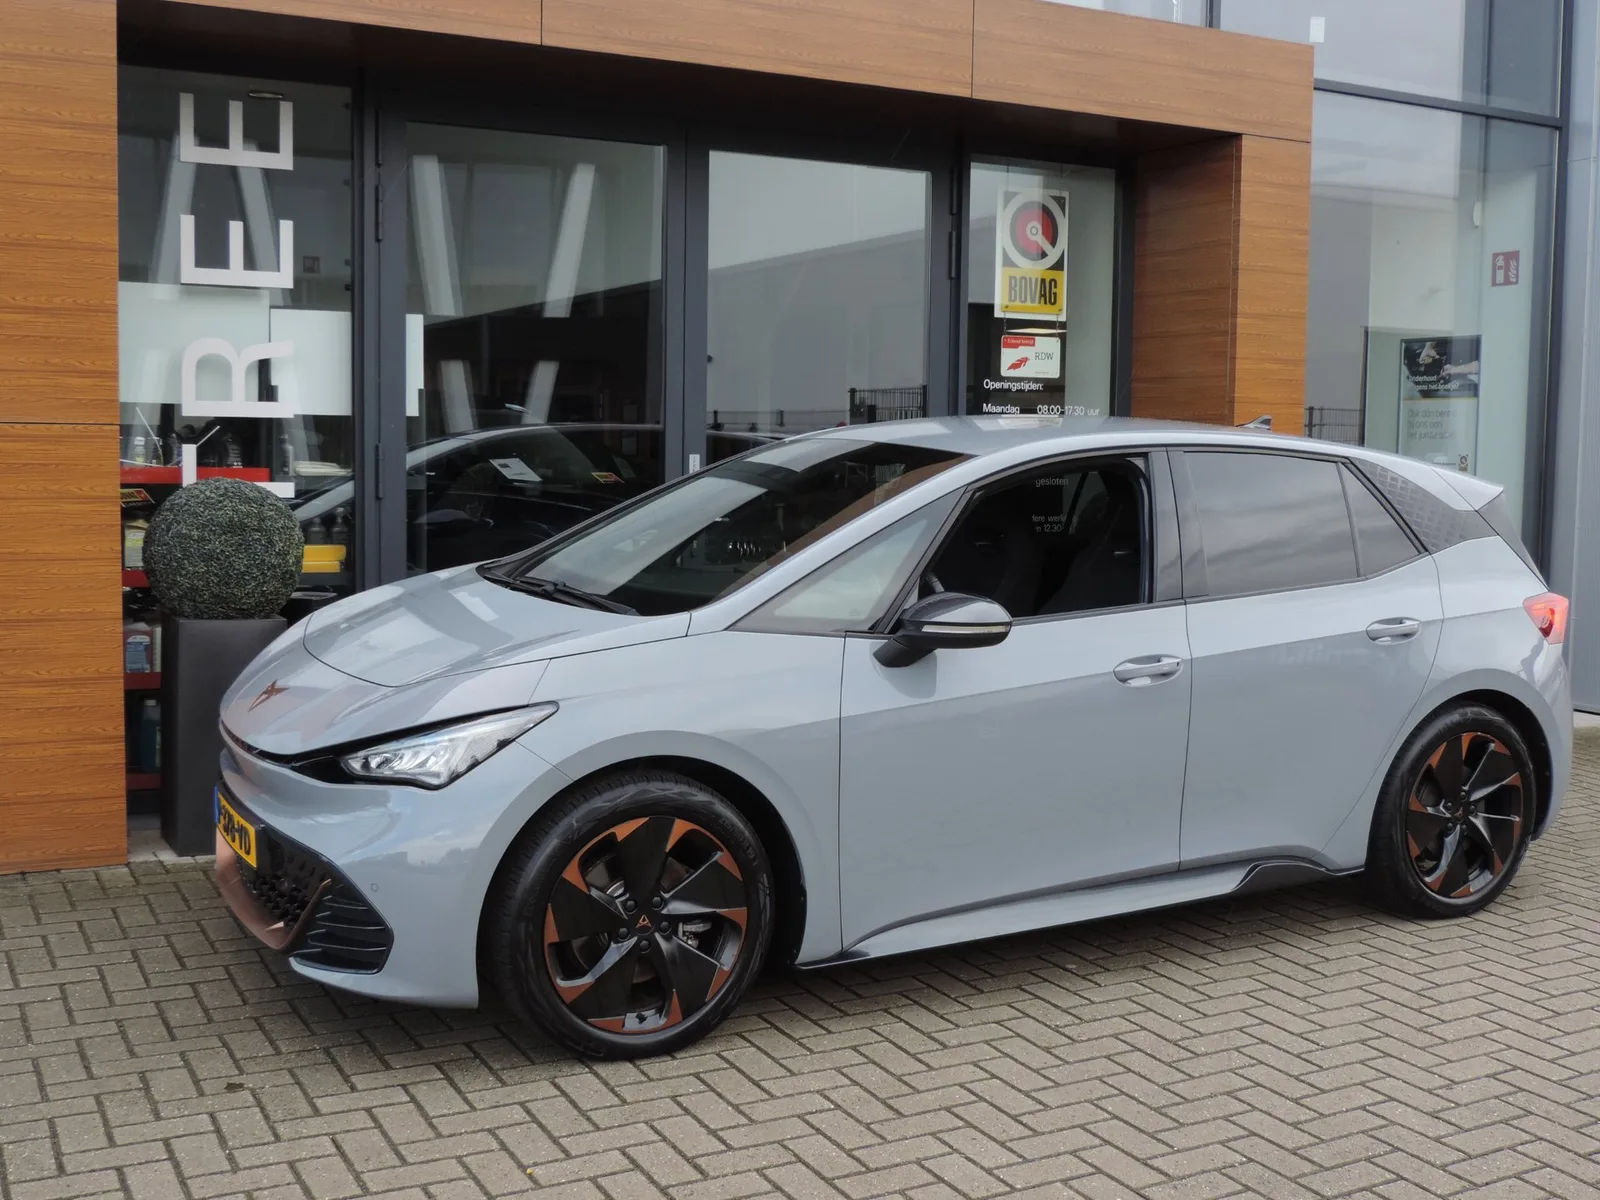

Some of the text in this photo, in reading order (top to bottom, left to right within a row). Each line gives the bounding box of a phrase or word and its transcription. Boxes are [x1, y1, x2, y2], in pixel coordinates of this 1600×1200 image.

[1008, 275, 1058, 306] BOVAG
[1034, 351, 1054, 361] RDW
[983, 379, 1044, 392] Openingstijden:
[982, 403, 1020, 416] Maandag
[1087, 408, 1101, 416] uur
[1035, 477, 1069, 488] gesloten
